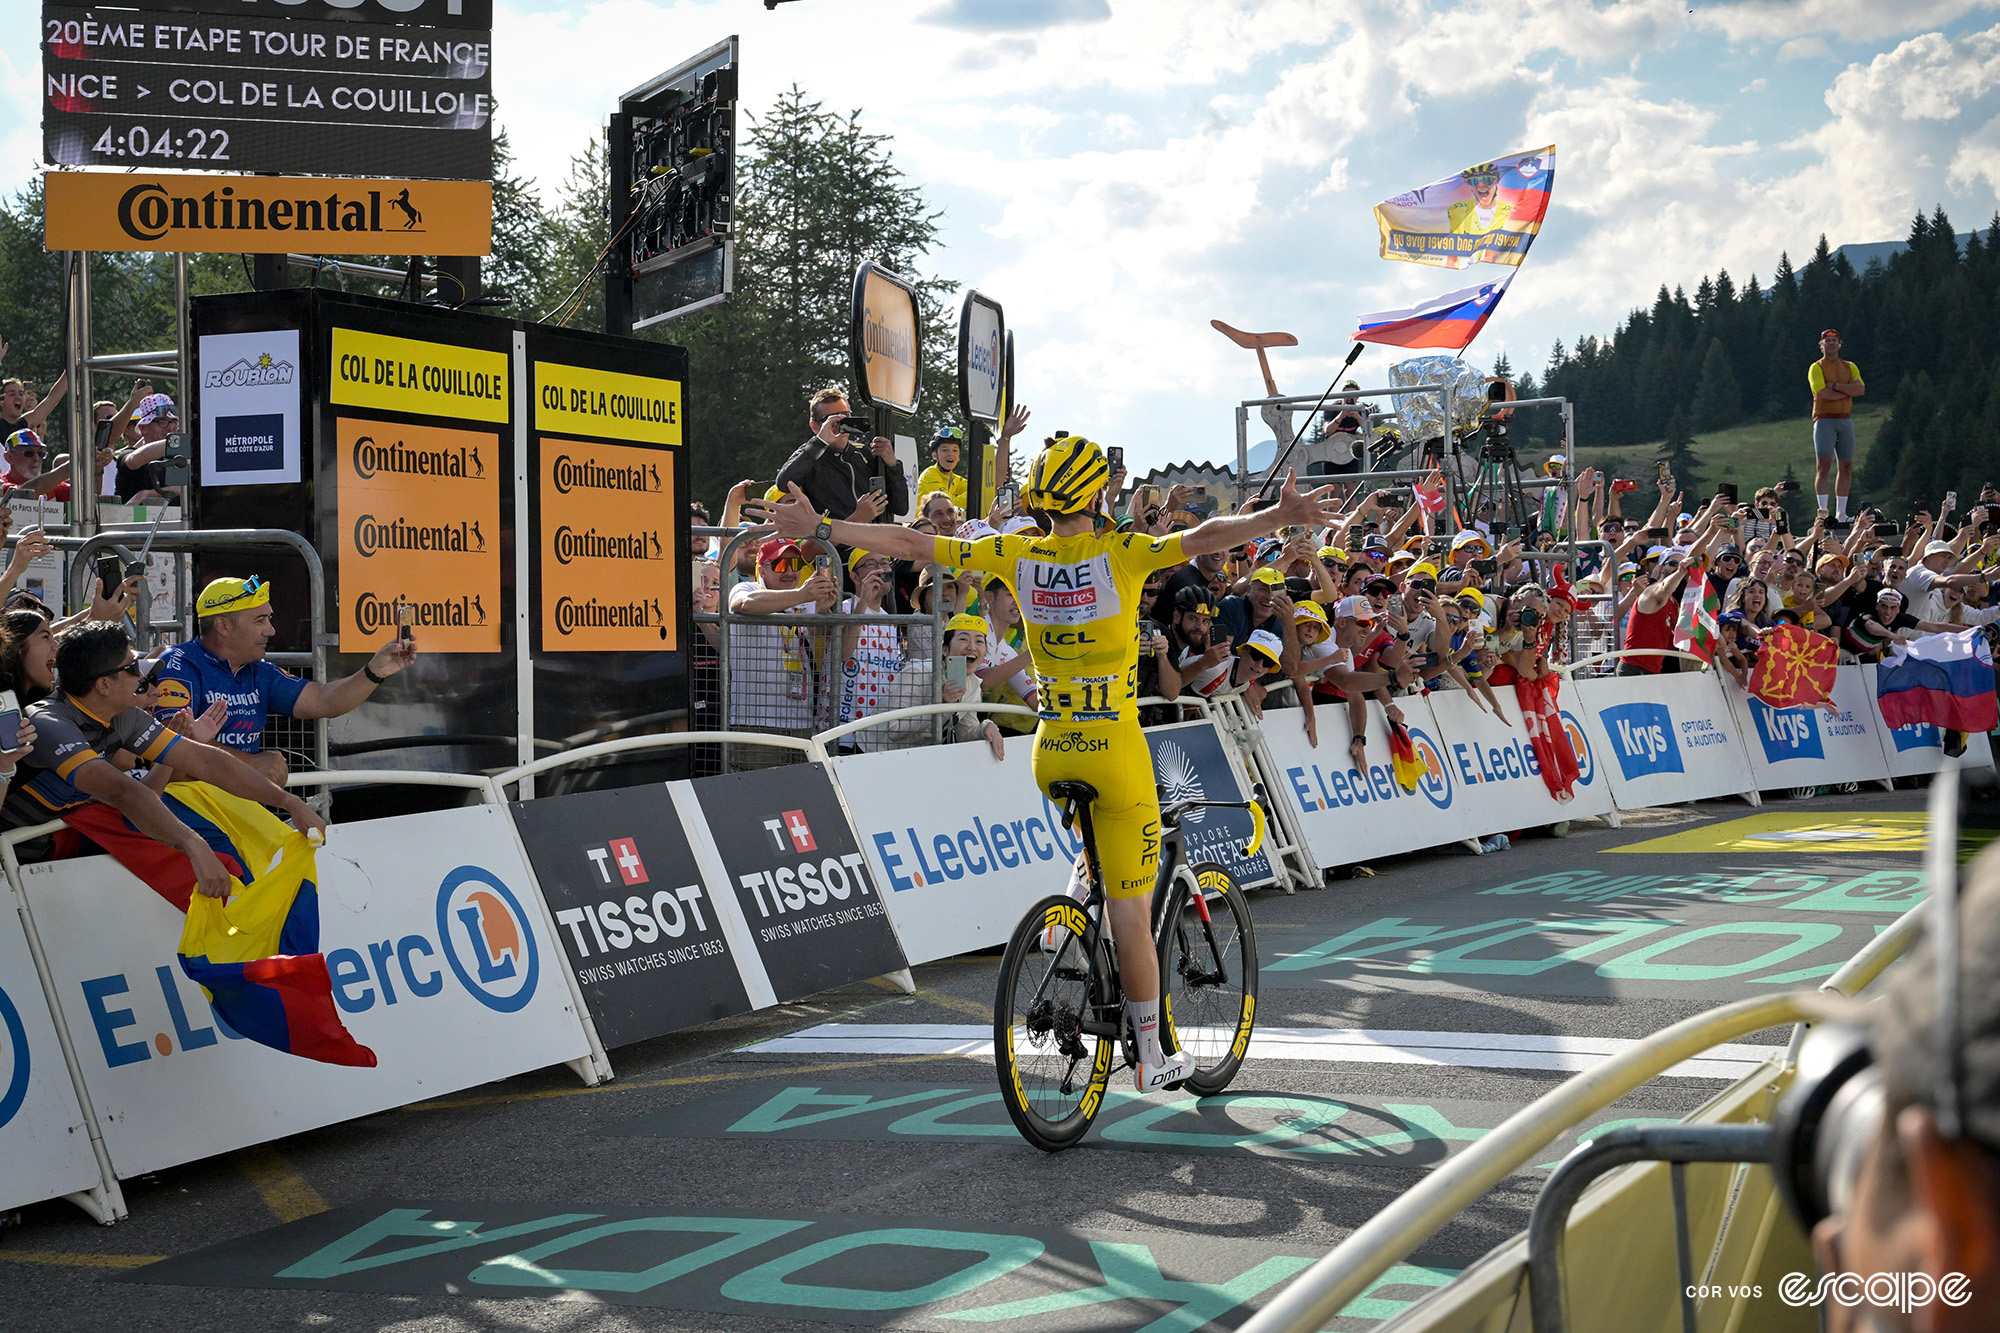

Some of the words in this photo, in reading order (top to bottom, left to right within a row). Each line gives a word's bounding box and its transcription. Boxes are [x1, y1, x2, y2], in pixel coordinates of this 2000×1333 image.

[46, 13, 144, 48] 20ÈME
[155, 25, 242, 53] ETAPE
[249, 30, 326, 57] TOUR
[336, 35, 370, 59] DE
[379, 37, 489, 66] FRANCE
[47, 73, 117, 99] NICE
[169, 79, 234, 104] COL
[242, 82, 277, 107] DE
[287, 84, 324, 109] LA
[331, 87, 489, 116] COUILLOLE
[91, 125, 230, 160] 4:04:22
[117, 182, 383, 241] Continental
[864, 307, 907, 366] Continental
[968, 336, 991, 376] .Leclerc
[340, 353, 370, 383] COL
[374, 358, 395, 387] DE
[398, 362, 418, 390] LA
[422, 365, 502, 400] COUILLOLE
[542, 384, 567, 411] COL
[571, 388, 587, 415] DE
[590, 392, 607, 417] LA
[610, 393, 676, 425] COUILLOLE
[225, 434, 274, 446] MÉTROPOLE
[239, 445, 253, 453] CÔTE
[254, 445, 274, 453] D'AZUR
[353, 436, 468, 479] Continental
[553, 454, 648, 494] Continental
[1059, 466, 1074, 484] MET
[18, 502, 32, 513] Parcs
[33, 504, 60, 515] naonaux
[354, 514, 469, 557] Continental
[554, 525, 649, 565] Continental
[959, 541, 972, 566] CL
[1034, 563, 1092, 589] UAE
[555, 596, 650, 636] Continental
[1034, 591, 1094, 607] Emirates
[1045, 631, 1096, 645] LCL
[1081, 683, 1111, 711] 11
[1040, 737, 1109, 752] WHOOSH
[1616, 718, 1667, 763] Krys
[1681, 718, 1714, 734] OPTIQUE
[1686, 736, 1694, 748] &
[1694, 732, 1728, 747] AUDITION
[1761, 707, 1811, 749] Krys
[1828, 726, 1835, 737] &
[1834, 724, 1866, 736] AUDITION
[1453, 738, 1541, 785] E.Lecle
[1286, 762, 1416, 813] E.Lecler
[872, 816, 1052, 892] E.Leclerc
[1141, 820, 1158, 866] UAE
[1184, 825, 1231, 846] XPLORE
[739, 852, 870, 918] TISSOT
[555, 884, 707, 958] TISSOT
[760, 925, 791, 943] SWISS
[791, 913, 836, 936] WATCHES
[835, 908, 865, 925] SINCE
[864, 902, 885, 918] 1853
[579, 964, 615, 985] SWISS
[614, 952, 668, 976] WATCHES
[668, 945, 700, 965] SINCE
[699, 939, 725, 957] 1853
[80, 934, 443, 1069] E.Lerc
[1140, 1013, 1157, 1024] UAE
[1150, 1065, 1183, 1086] DMT
